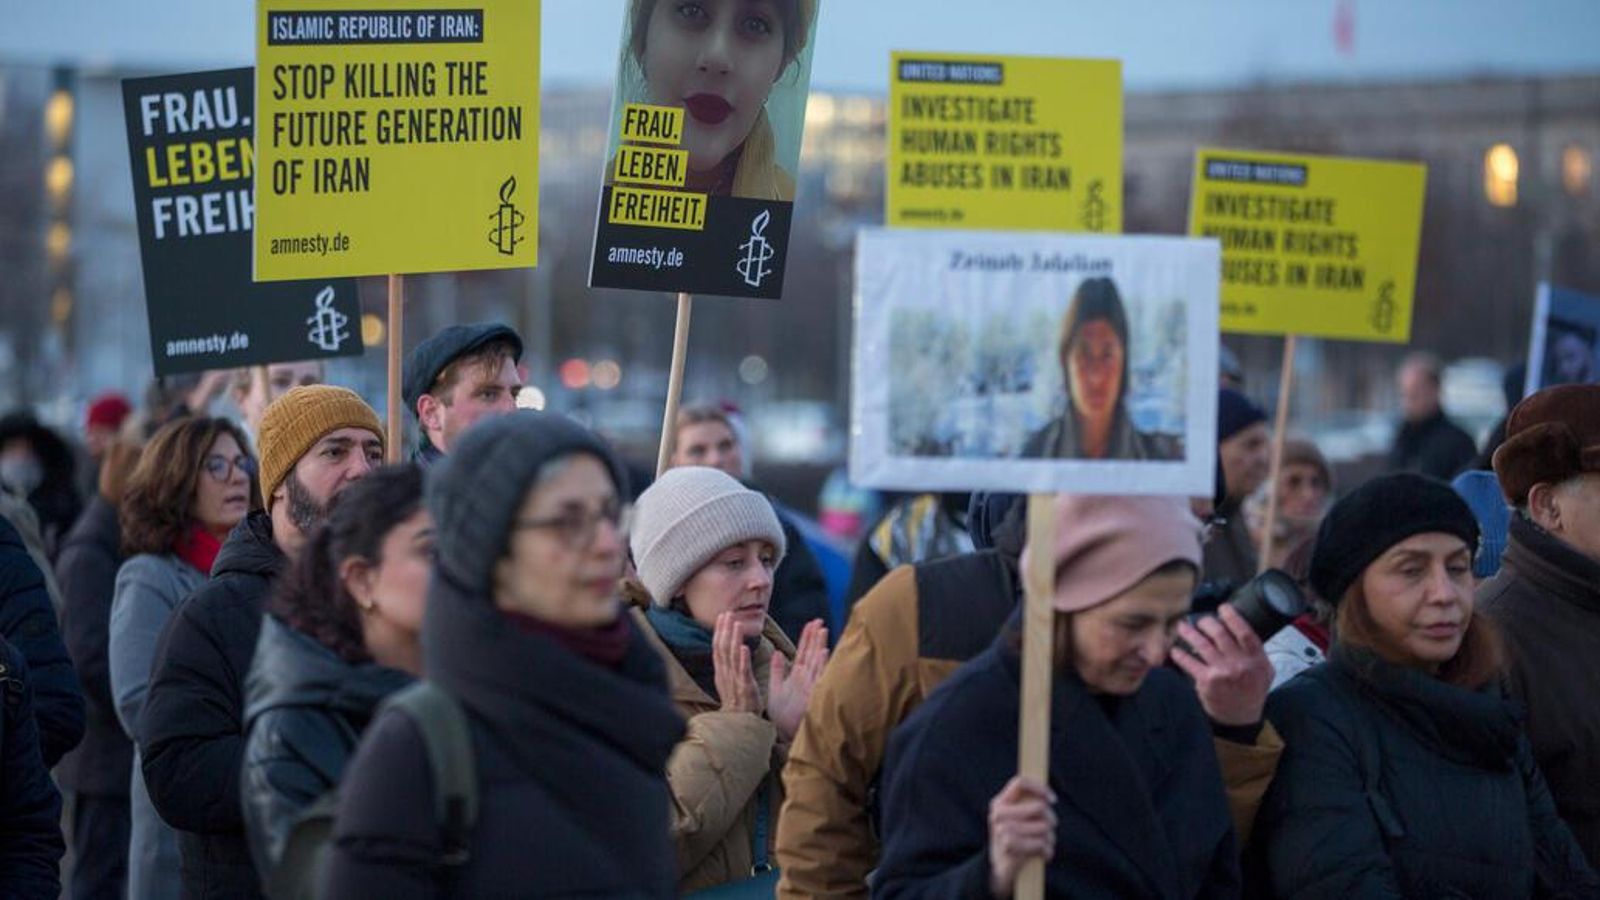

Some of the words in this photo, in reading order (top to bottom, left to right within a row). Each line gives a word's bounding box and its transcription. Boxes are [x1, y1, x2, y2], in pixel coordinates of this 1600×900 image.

[273, 17, 334, 40] ISLAMIC
[339, 15, 411, 39] REPUBLIC
[417, 15, 435, 38] OF
[440, 14, 480, 37] IRAN:
[273, 64, 335, 100] STOP
[345, 62, 435, 98] KILLING
[445, 61, 488, 96] THE
[140, 86, 250, 136] FRAU.
[623, 108, 678, 140] FRAU.
[902, 95, 1035, 124] INVESTIGATE
[273, 110, 367, 147] FUTURE
[376, 106, 522, 144] GENERATION
[901, 128, 977, 155] HUMAN
[985, 131, 1062, 158] RIGHTS
[273, 159, 304, 196] OF
[314, 157, 370, 193] IRAN
[618, 149, 683, 182] LEBEN.
[902, 162, 983, 189] ABUSES
[992, 164, 1014, 190] IN
[1022, 166, 1071, 192] IRAN
[612, 192, 703, 226] FREIHEIT.
[1207, 193, 1335, 224] INVESTIGATE
[271, 232, 349, 256] amnesty.de
[608, 246, 684, 270] amnesty.de
[1283, 231, 1358, 259] RIGHTS
[1221, 259, 1278, 286] USES
[1287, 262, 1307, 285] IN
[1315, 265, 1364, 289] IRAN
[166, 331, 248, 357] amnesty.de
